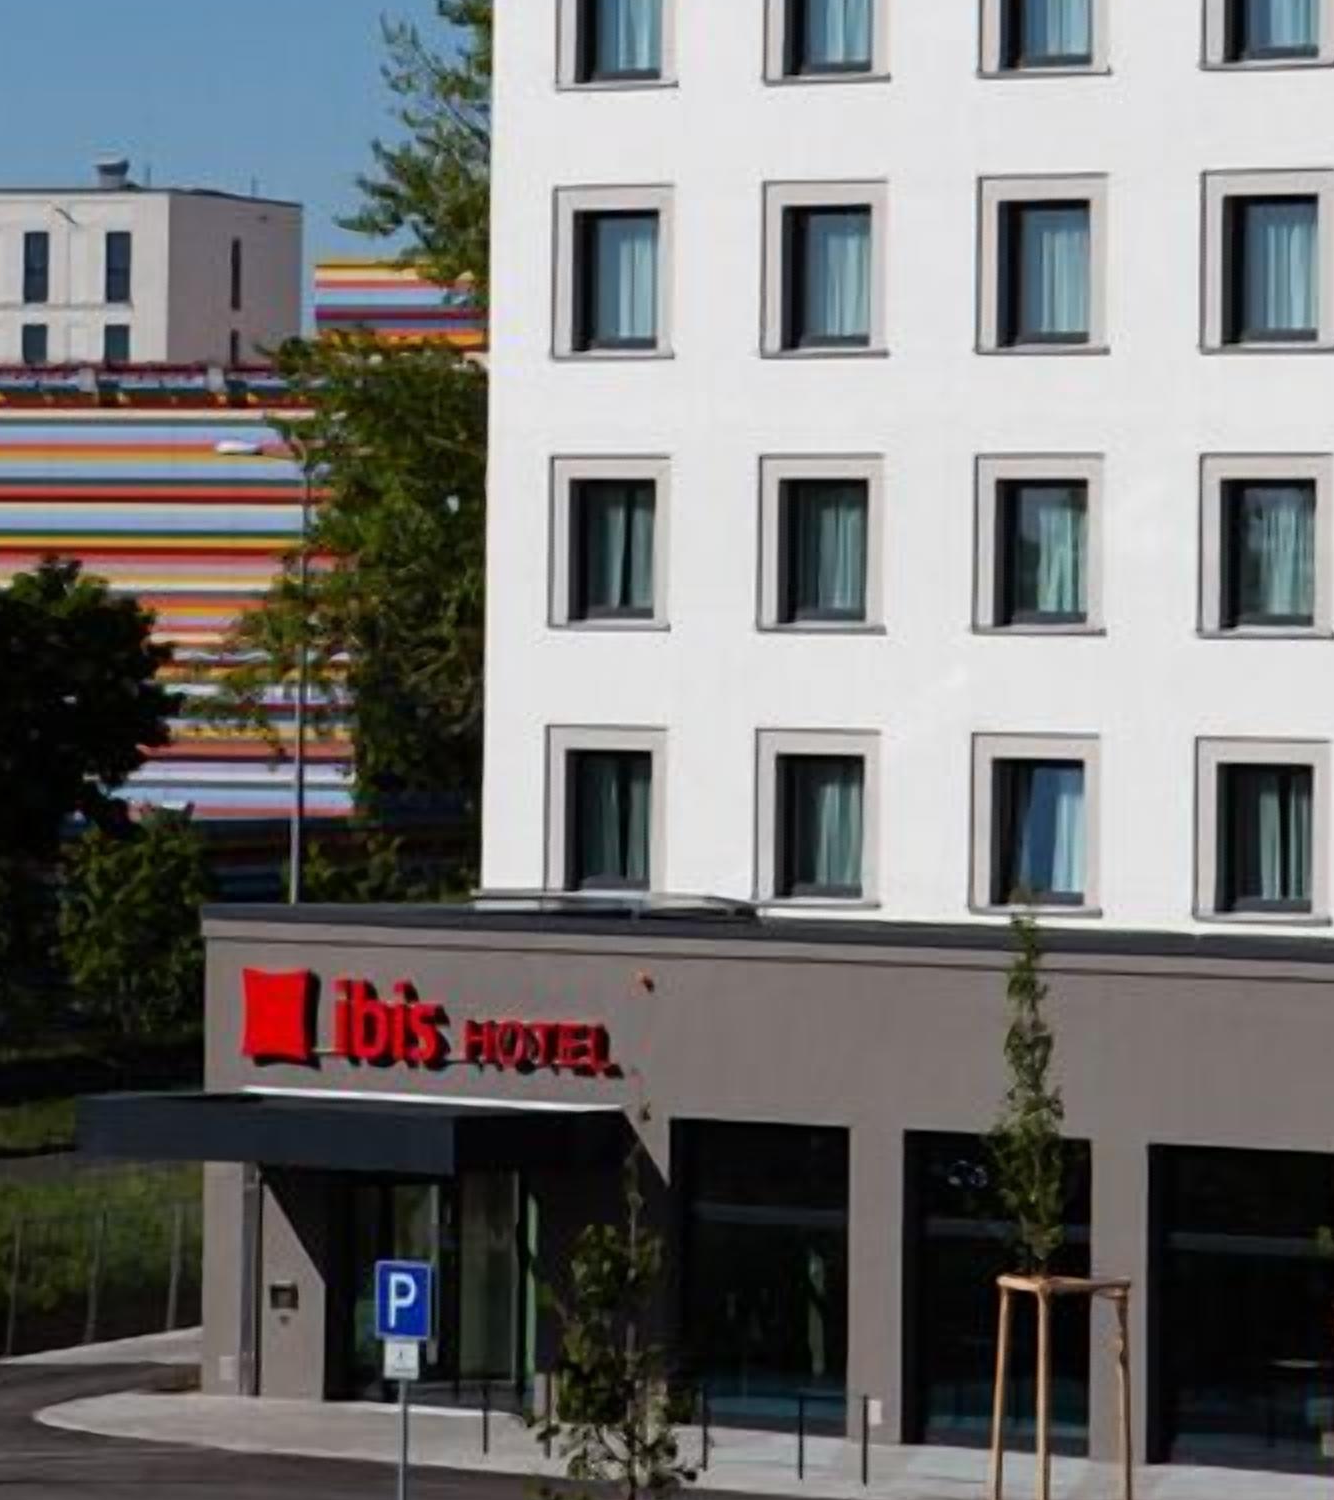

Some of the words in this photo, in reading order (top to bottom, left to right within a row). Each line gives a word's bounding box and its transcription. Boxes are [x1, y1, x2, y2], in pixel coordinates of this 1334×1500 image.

[334, 979, 445, 1064] ibis
[464, 1020, 613, 1072] HOTEL
[388, 1272, 417, 1328] P
